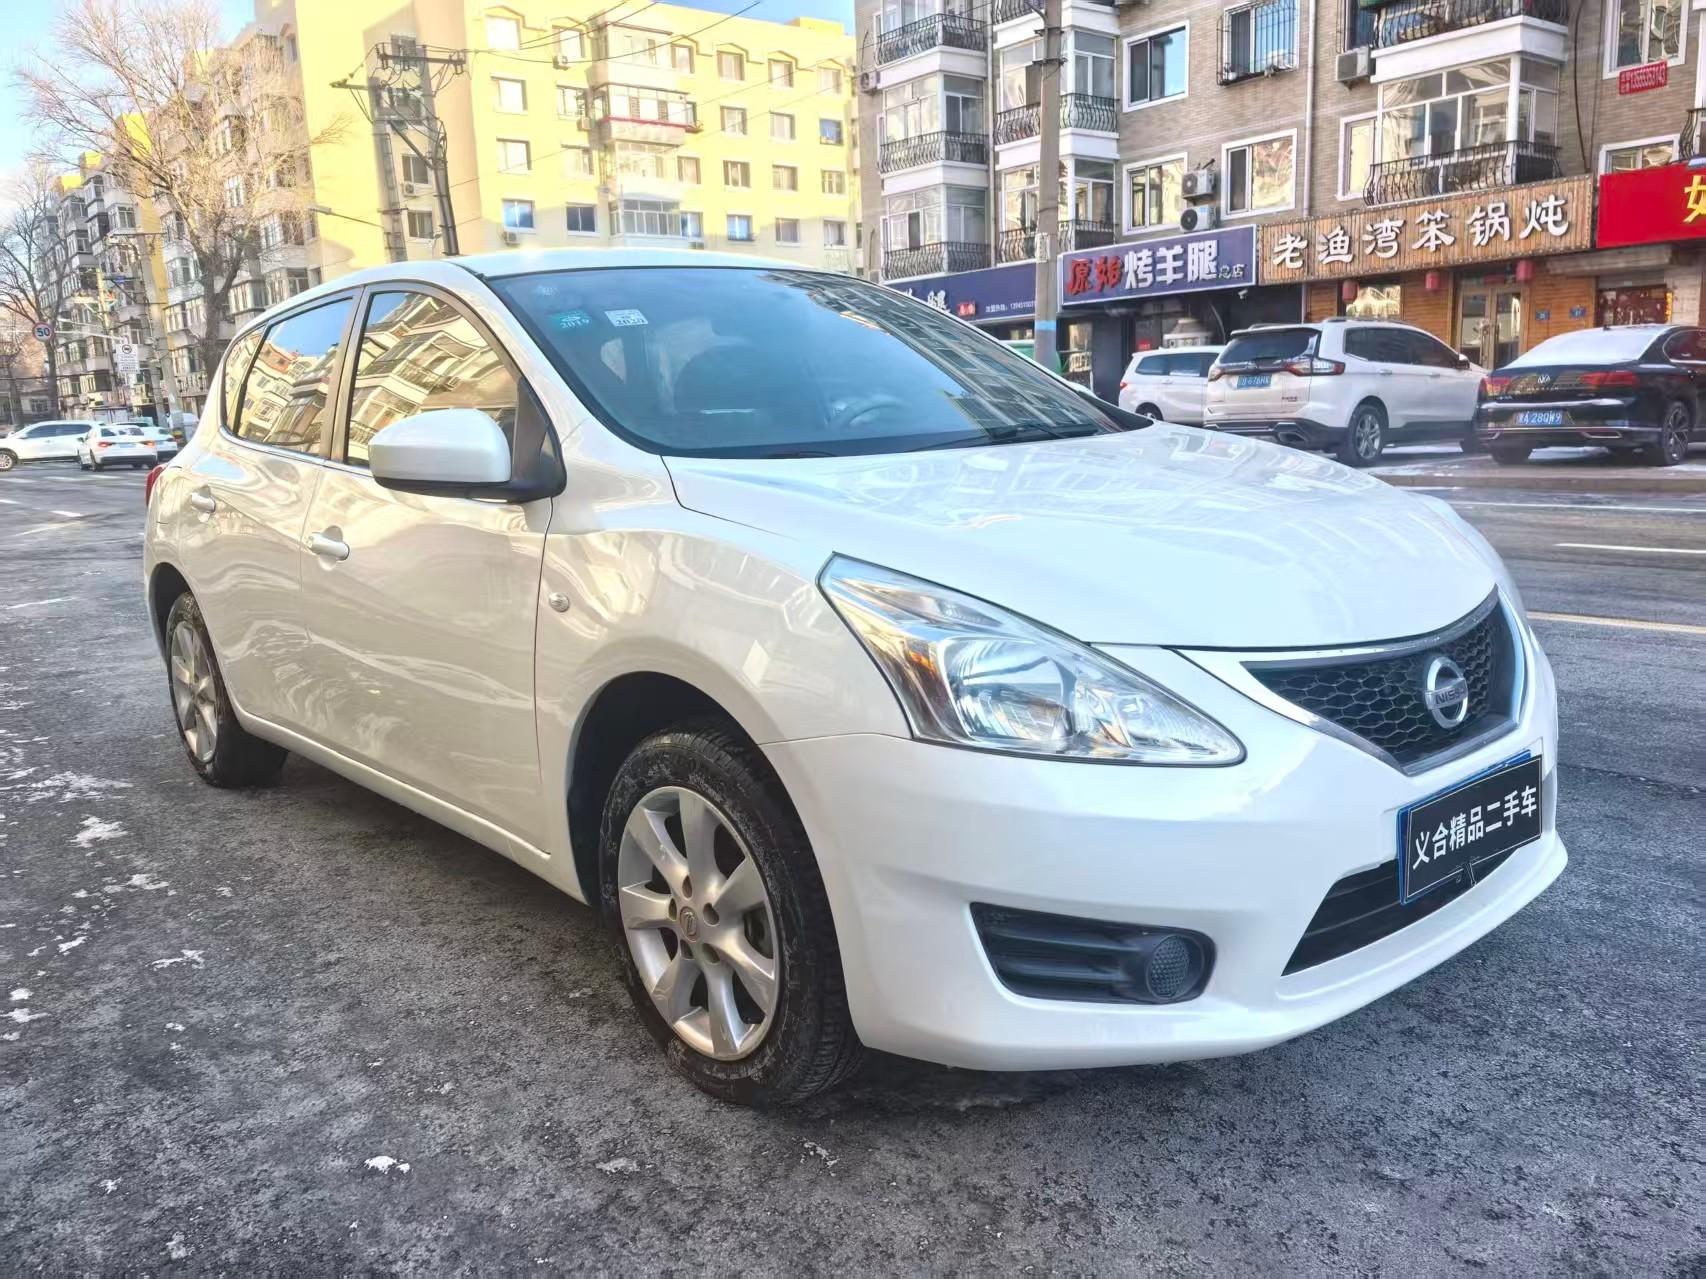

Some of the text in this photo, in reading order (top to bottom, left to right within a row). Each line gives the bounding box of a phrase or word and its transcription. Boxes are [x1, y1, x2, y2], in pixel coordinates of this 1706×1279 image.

[1272, 194, 1570, 269] 老渔湾笨锅炖
[36, 327, 51, 337] 50
[1412, 785, 1538, 870] 义合精品二手车
